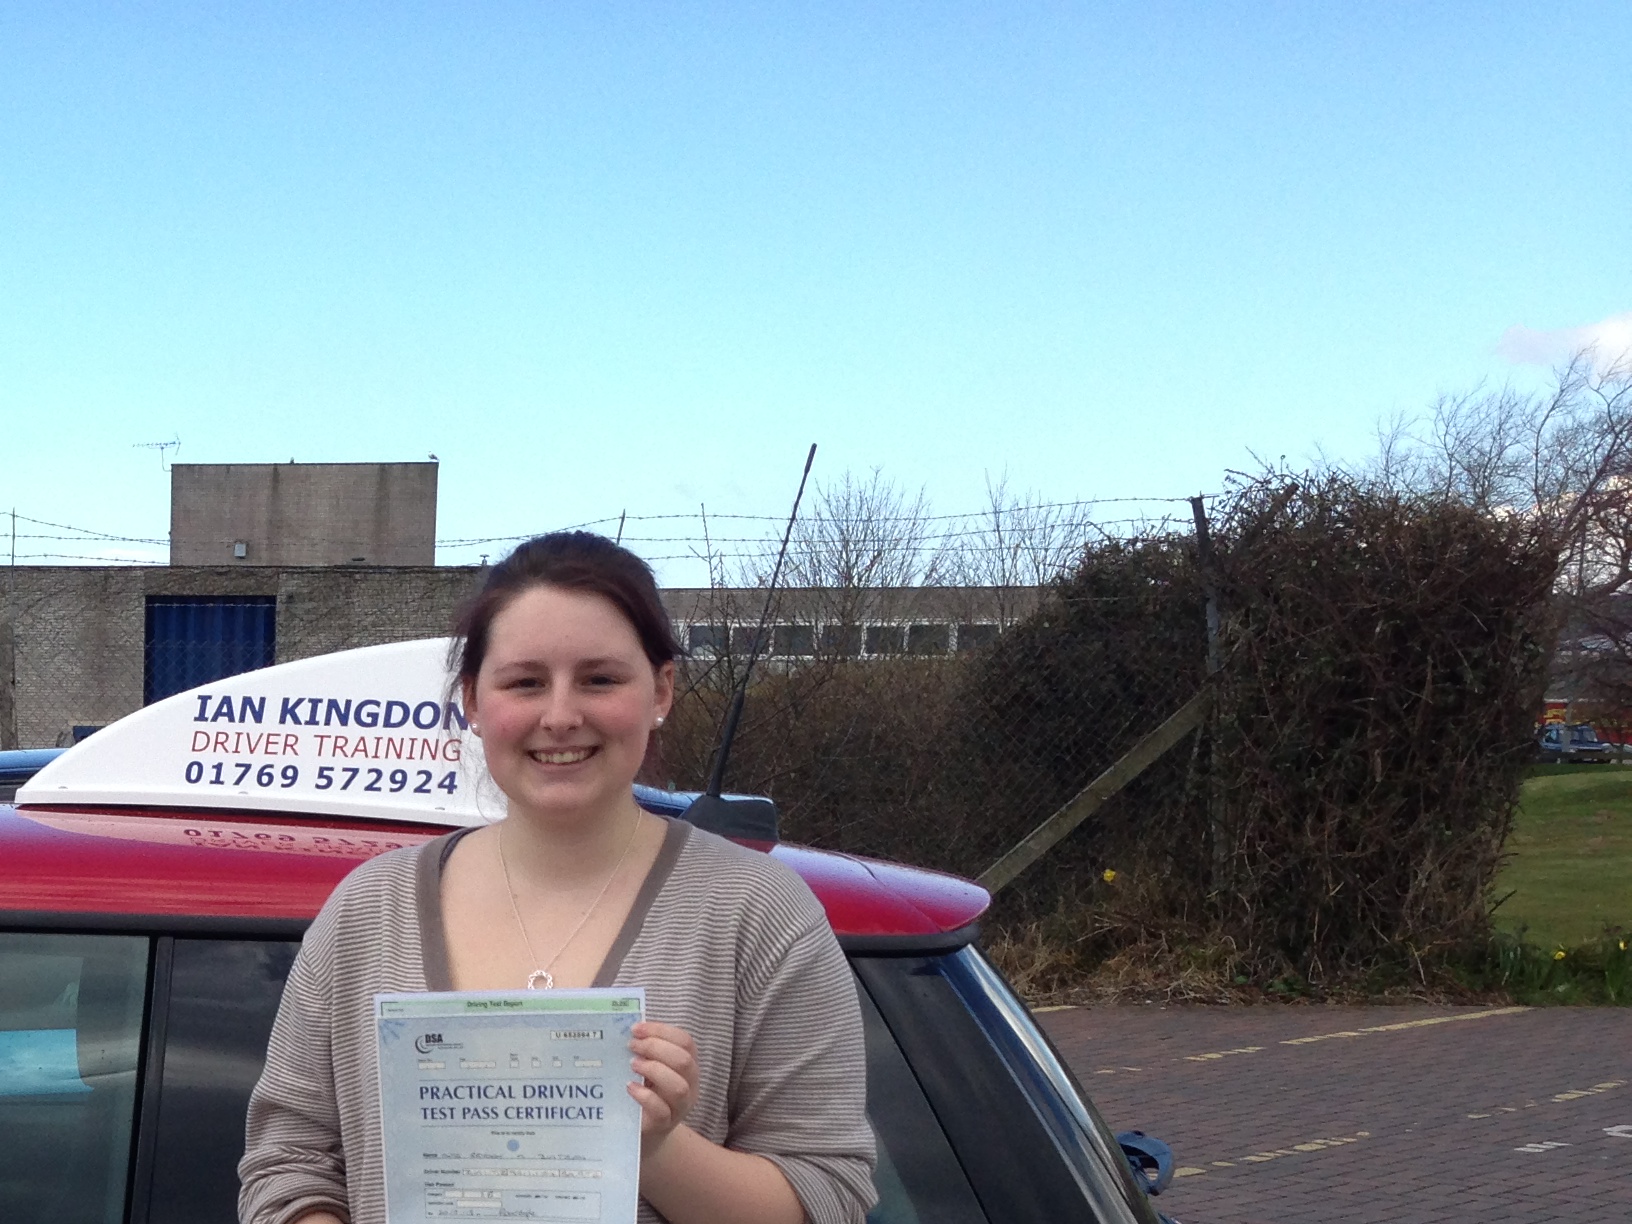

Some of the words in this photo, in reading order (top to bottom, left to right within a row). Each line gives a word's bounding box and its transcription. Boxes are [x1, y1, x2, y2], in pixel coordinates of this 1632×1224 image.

[193, 694, 267, 724] IAN
[279, 697, 469, 731] KINGDON
[191, 730, 299, 756] DRIVER
[313, 734, 463, 762] TRAINING
[184, 760, 300, 789] 01769
[314, 765, 458, 795] 572924
[424, 1033, 444, 1044] DSA
[419, 1085, 516, 1100] PRACTICAL
[523, 1084, 604, 1099] DRIVING
[421, 1107, 457, 1120] TEST
[462, 1107, 499, 1120] PASS
[504, 1106, 604, 1120] CERTIFICATE
